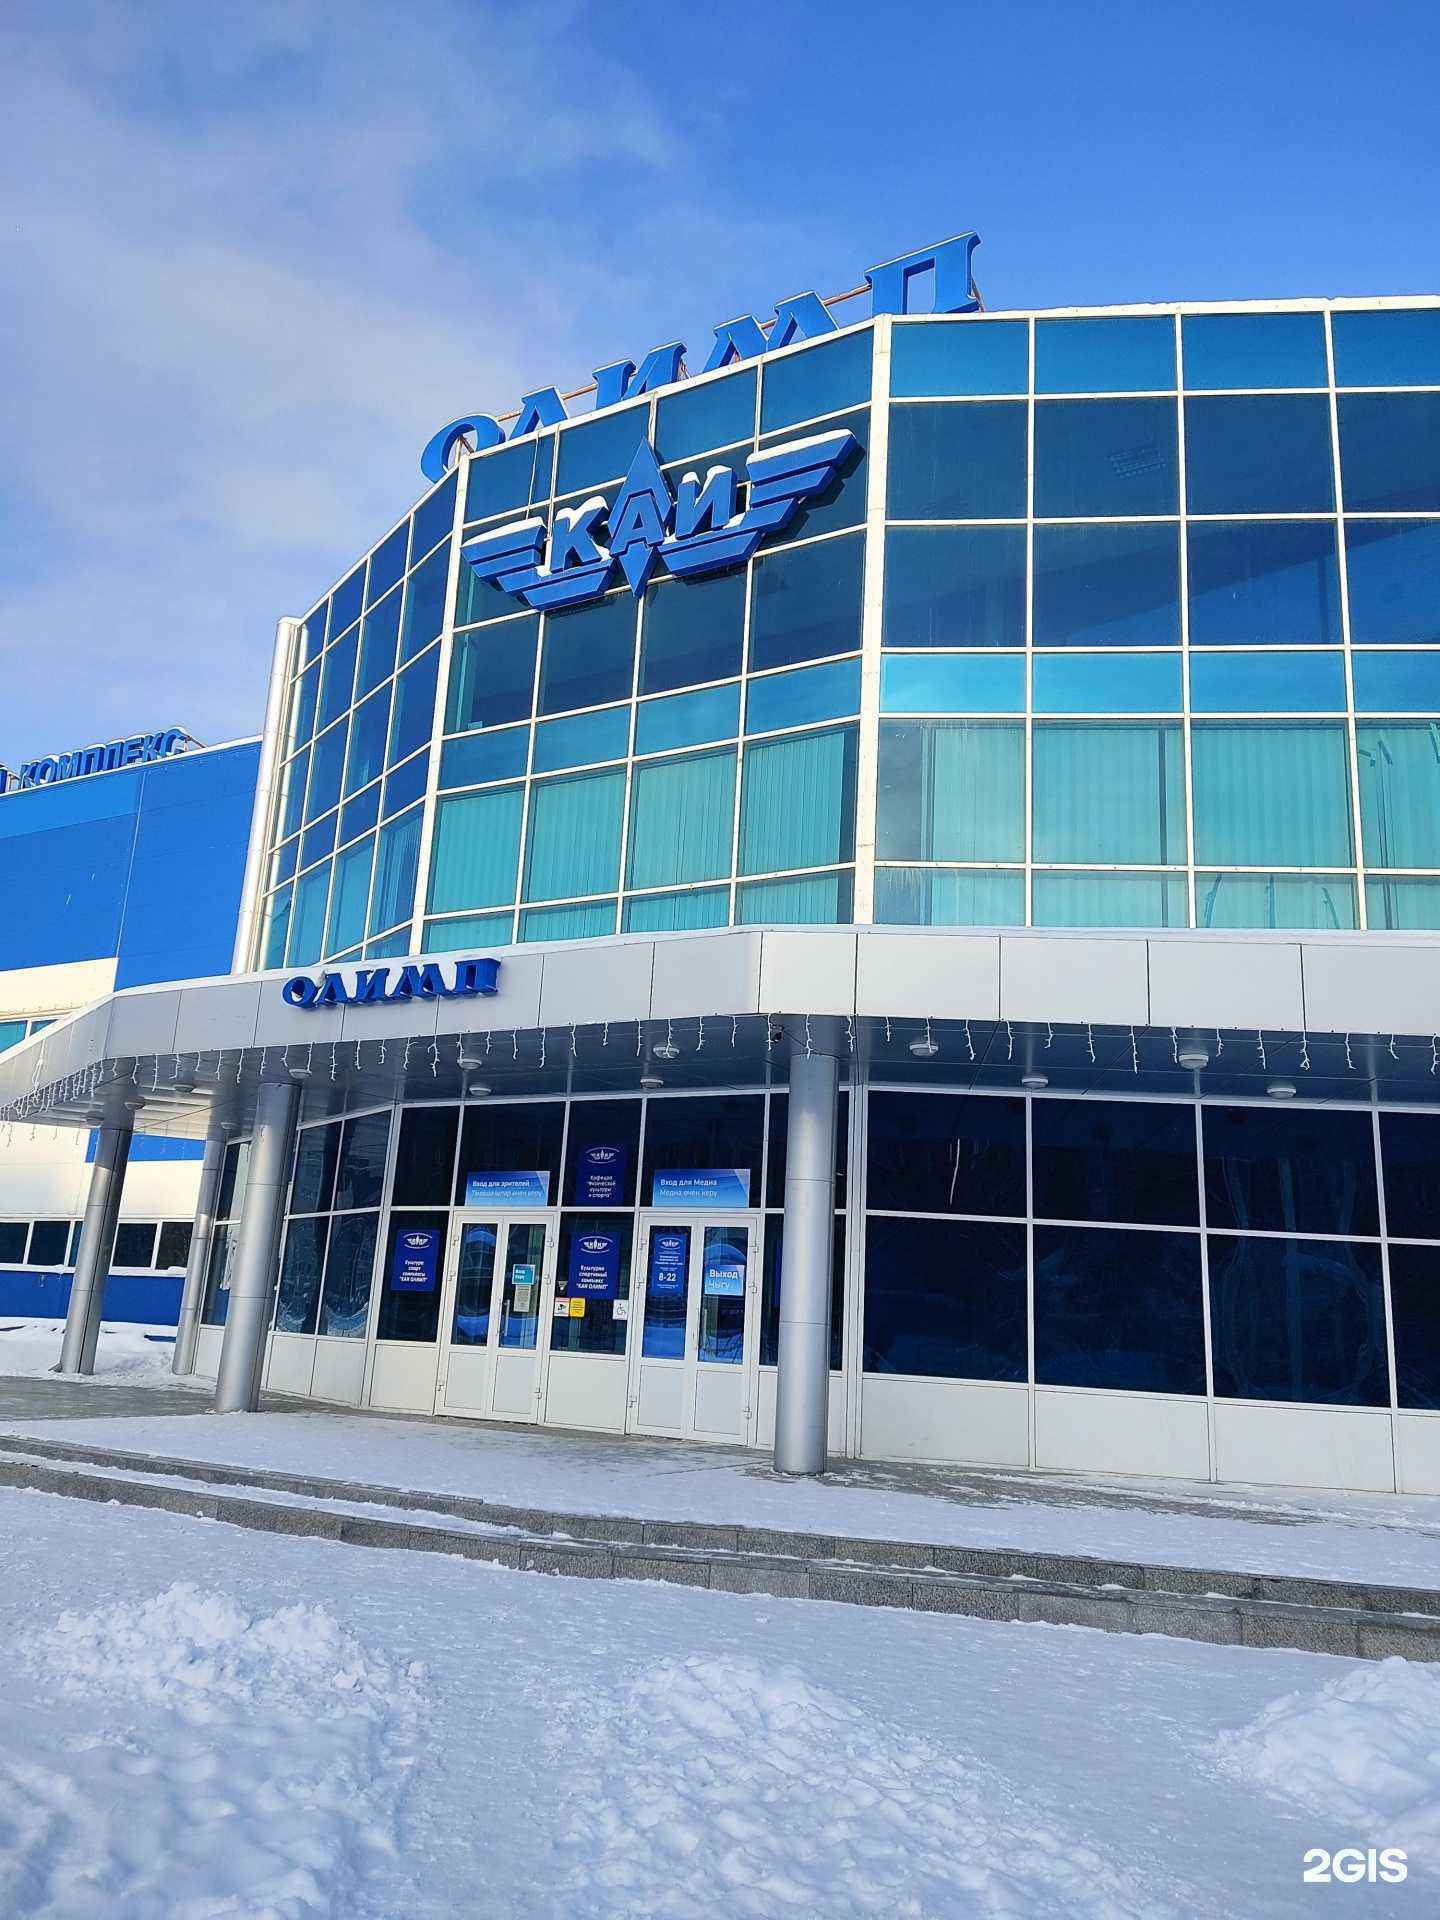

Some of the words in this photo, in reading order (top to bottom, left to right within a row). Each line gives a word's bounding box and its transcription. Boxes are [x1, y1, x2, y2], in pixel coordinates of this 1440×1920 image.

[420, 231, 982, 484] ОЛИМП
[551, 437, 738, 572] КАИ
[19, 727, 190, 789] КОМПЛЕКС
[282, 957, 501, 1009] ОЛИМП
[472, 1180, 488, 1188] Вход
[488, 1180, 500, 1188] для
[501, 1180, 530, 1188] зрителей
[660, 1179, 678, 1187] Вход
[678, 1179, 693, 1187] для
[693, 1179, 718, 1187] Медиа
[658, 1272, 677, 1282] 8-22
[709, 1269, 738, 1279] Выход
[708, 1279, 730, 1289] Чыгу
